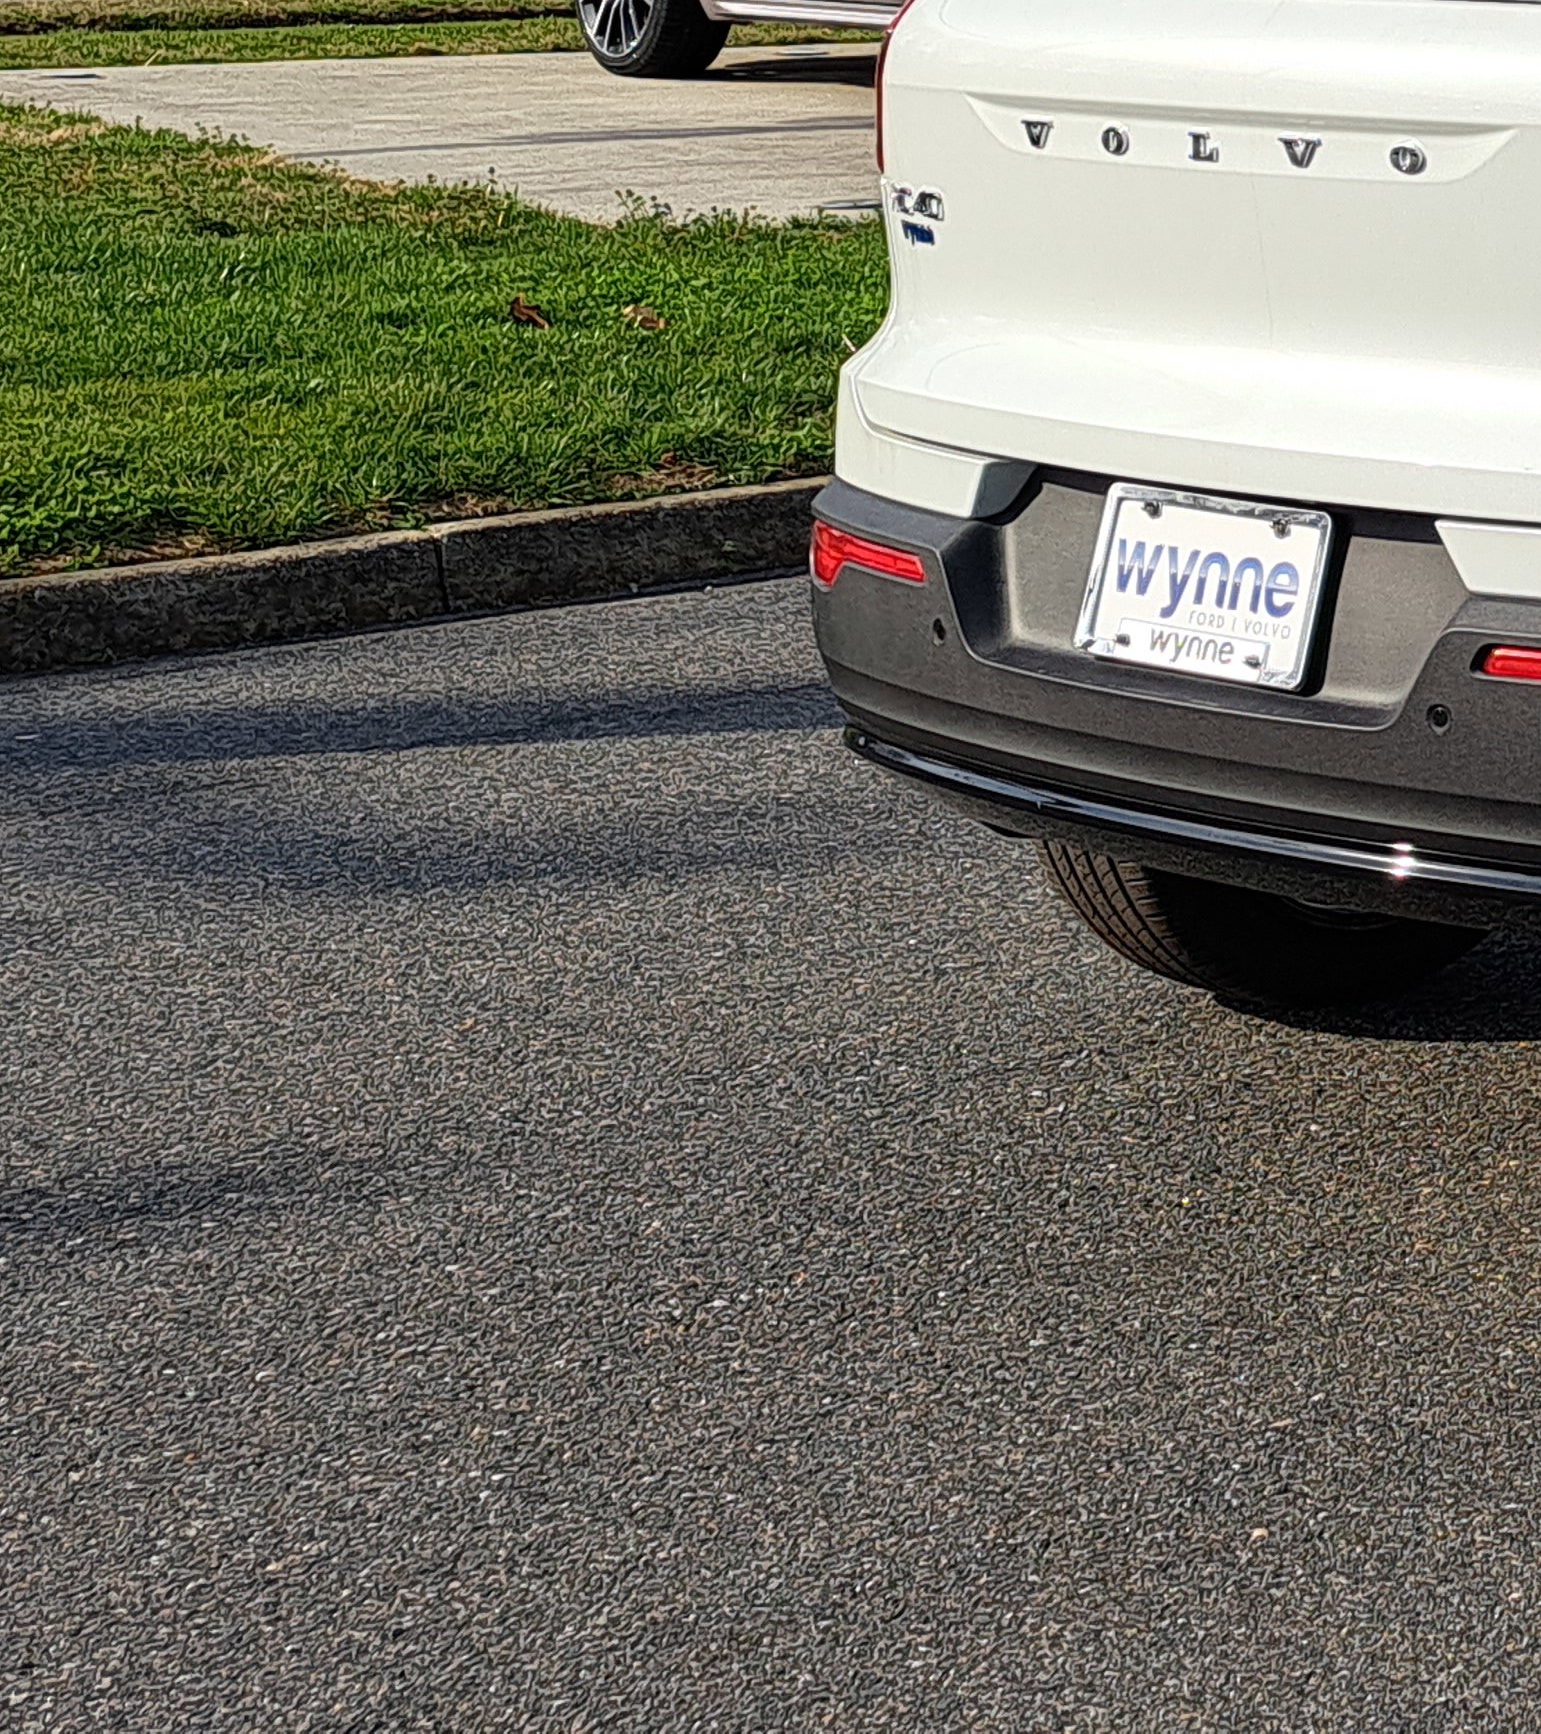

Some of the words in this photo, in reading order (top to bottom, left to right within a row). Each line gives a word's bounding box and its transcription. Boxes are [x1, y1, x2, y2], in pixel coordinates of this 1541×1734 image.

[1020, 120, 1428, 176] VOLVO
[1115, 537, 1300, 619] wynne
[1149, 627, 1235, 665] wynne
[1187, 609, 1225, 630] FORD
[1243, 618, 1292, 639] VOLVO
